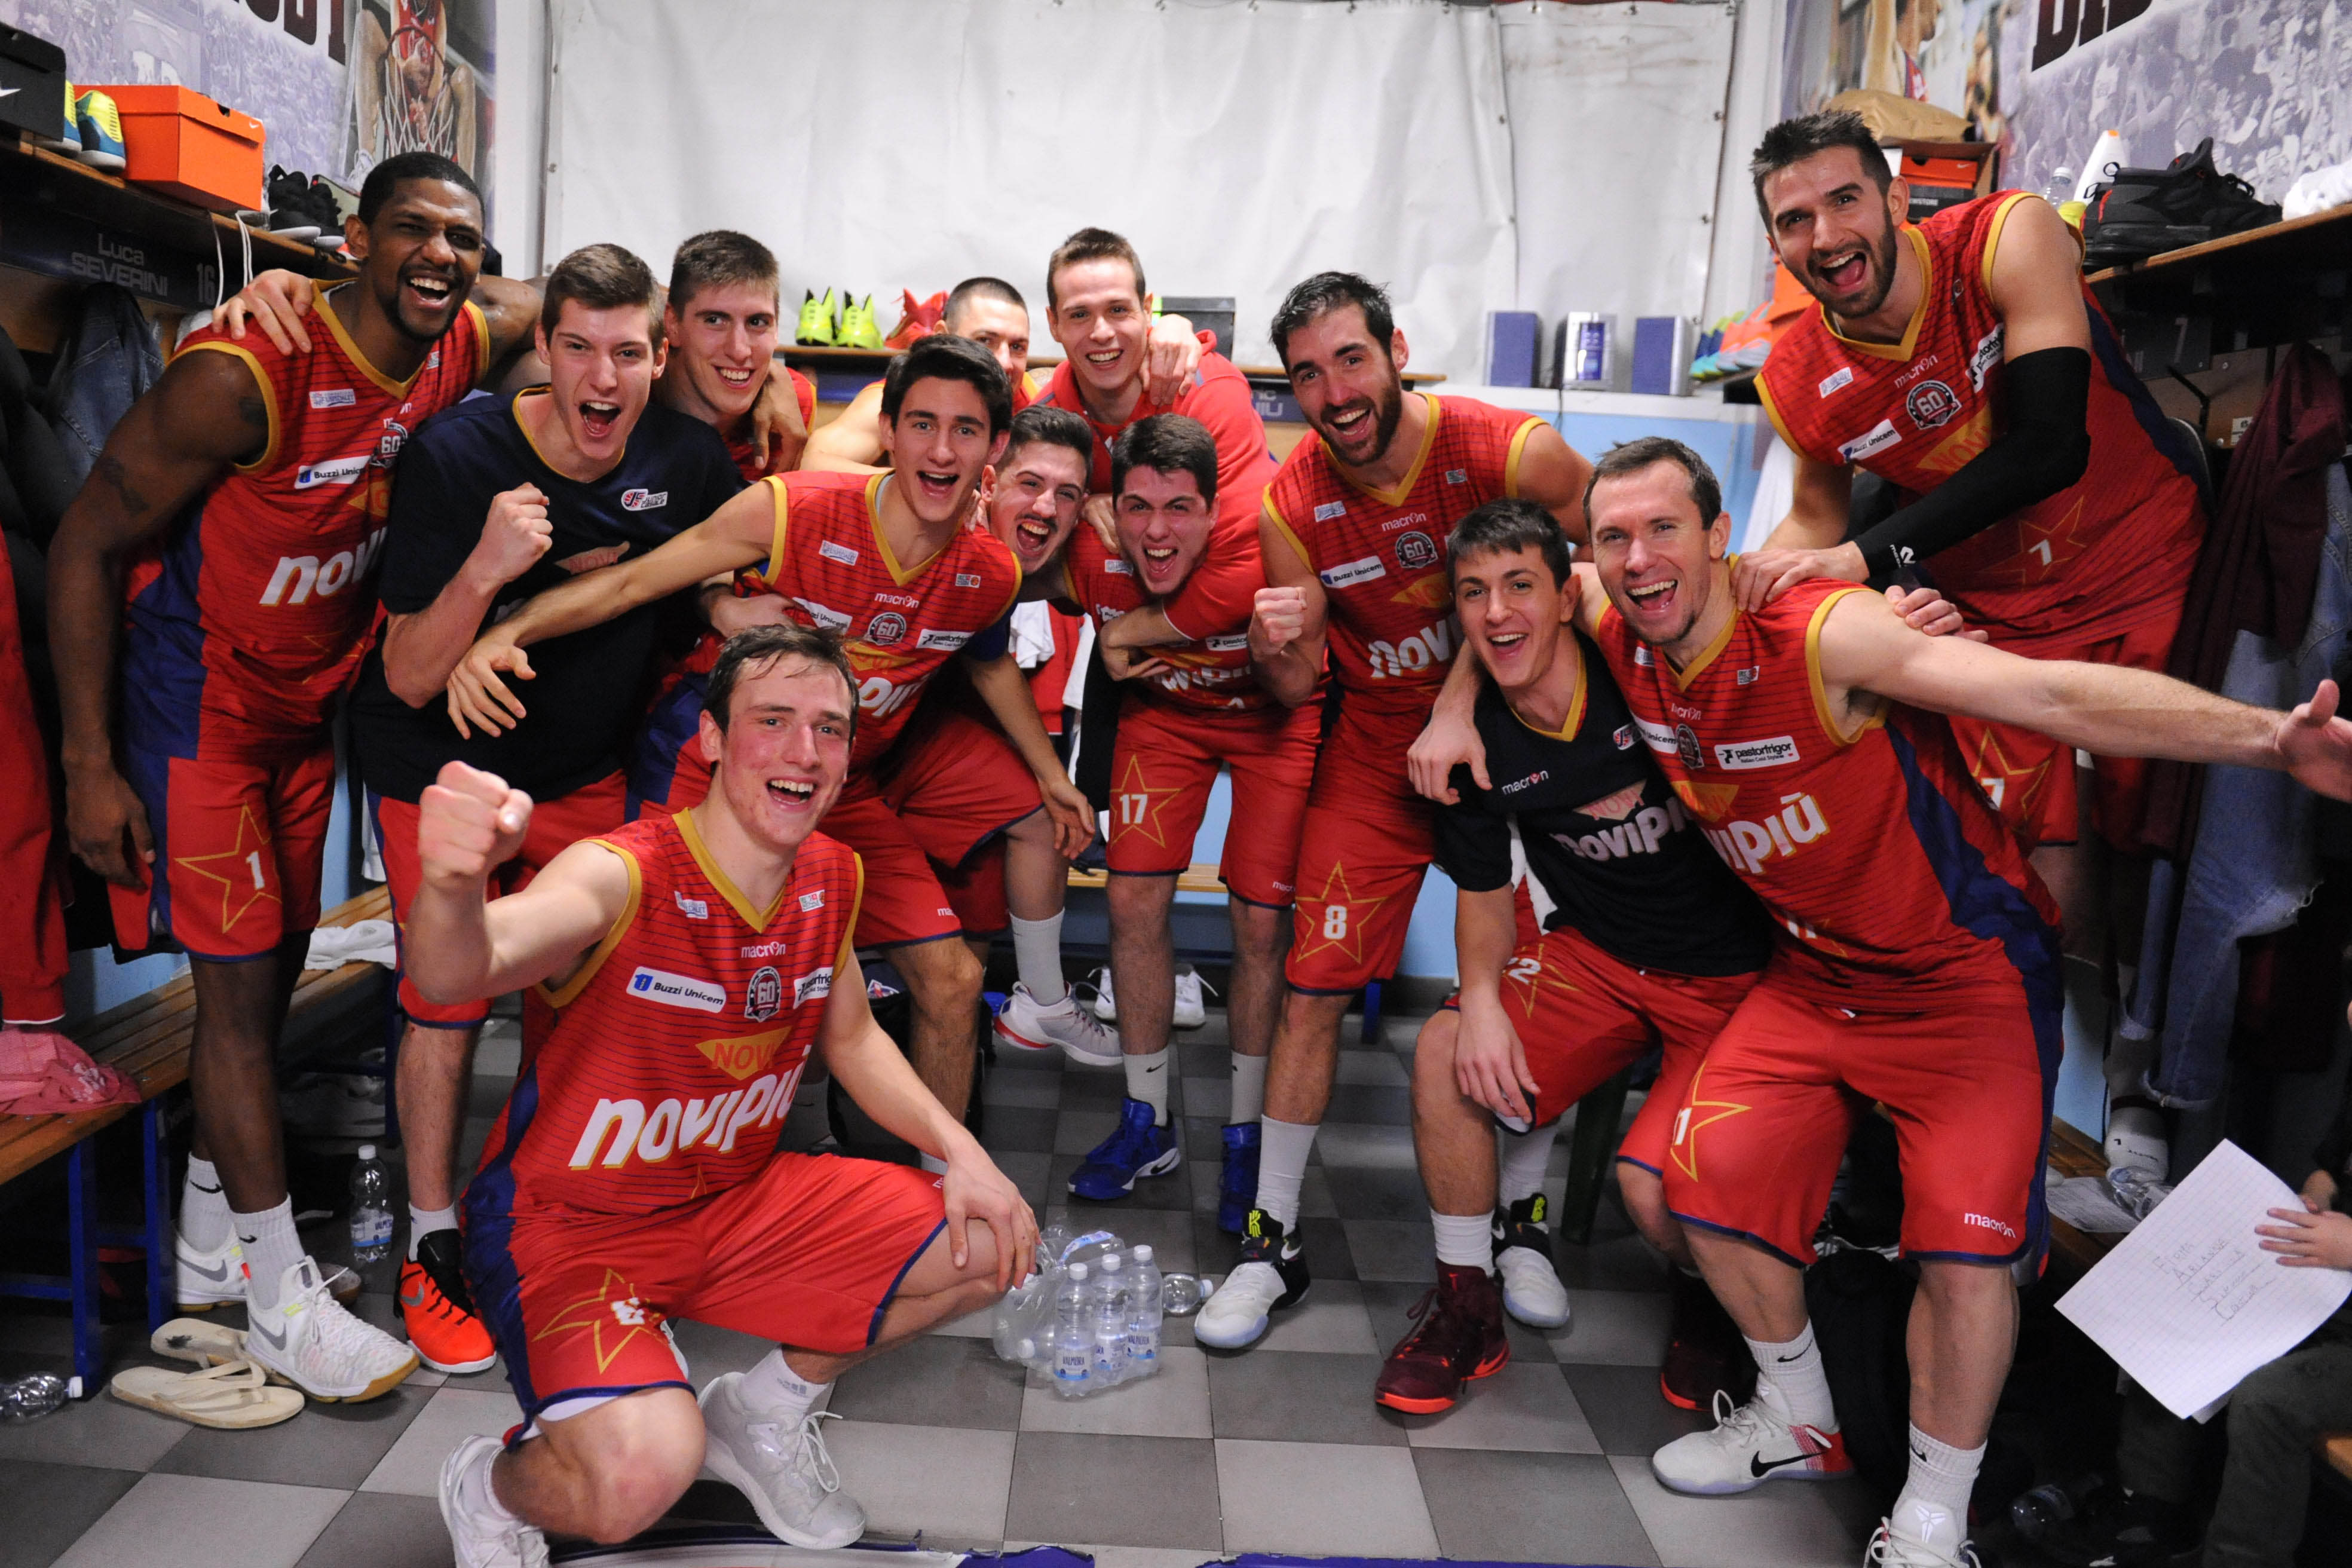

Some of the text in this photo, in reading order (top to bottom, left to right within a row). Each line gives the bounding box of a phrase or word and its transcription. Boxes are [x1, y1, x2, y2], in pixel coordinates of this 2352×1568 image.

[98, 233, 144, 266] Luca
[72, 252, 167, 296] SEVERINI
[197, 263, 215, 305] 16
[1916, 390, 1944, 416] 60
[381, 436, 400, 454] 60
[1868, 429, 1895, 446] Unicem
[314, 468, 339, 479] Buzzi
[1381, 512, 1427, 531] macron
[1404, 541, 1425, 559] 60
[2029, 539, 2053, 566] 7
[1333, 562, 1382, 582] Buzzi Unicem
[874, 592, 920, 609] macron
[877, 620, 898, 637] 60
[1735, 743, 1791, 760] pastorfrigor
[1502, 769, 1549, 795] macron
[1119, 794, 1149, 825] 17
[246, 851, 265, 889] 1
[1323, 905, 1348, 940] 8
[741, 941, 786, 959] macron
[654, 982, 724, 1006] Buzzi Unicem
[757, 980, 775, 1005] 60
[1964, 1212, 2017, 1239] macron
